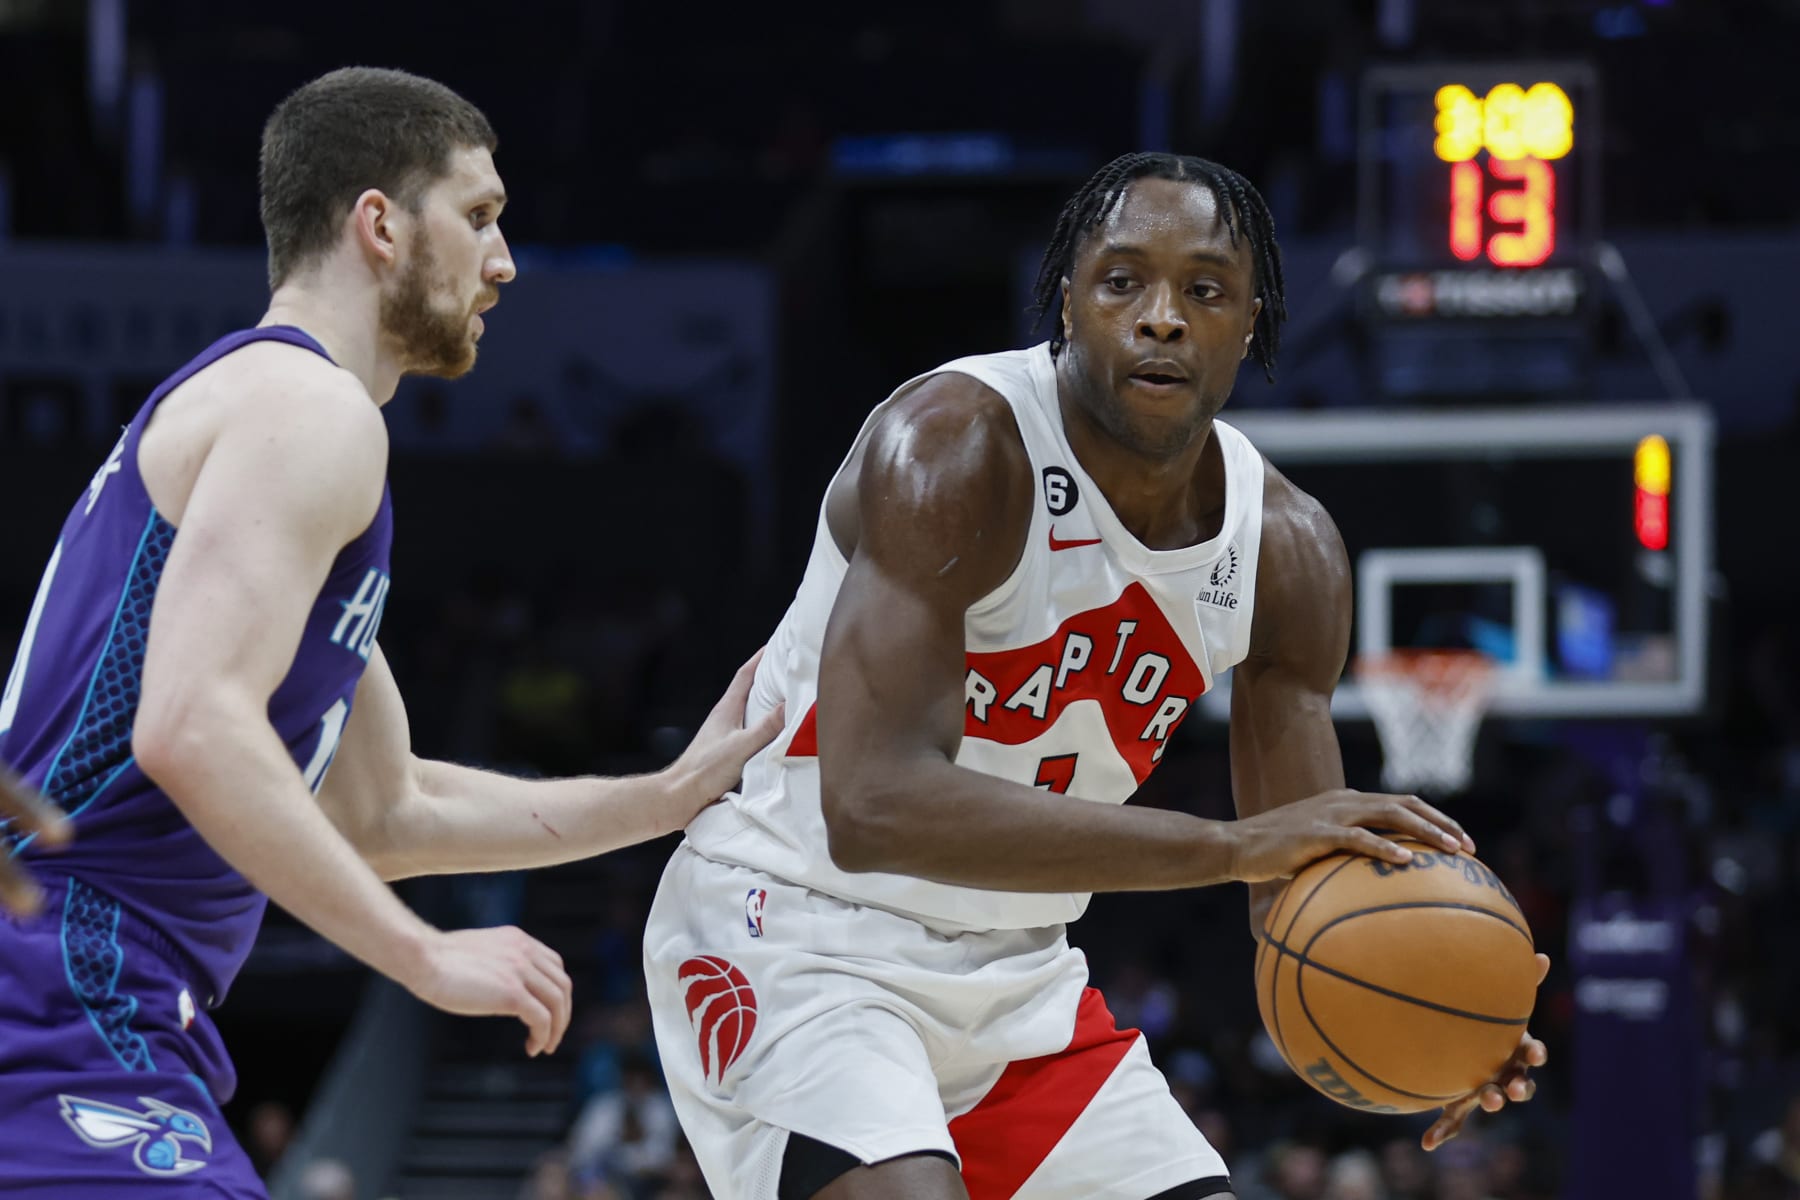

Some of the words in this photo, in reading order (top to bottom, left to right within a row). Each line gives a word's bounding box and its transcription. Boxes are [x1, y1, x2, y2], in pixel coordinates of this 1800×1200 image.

[1450, 156, 1555, 267] 13
[1045, 472, 1069, 511] 6
[1212, 590, 1238, 609] Life
